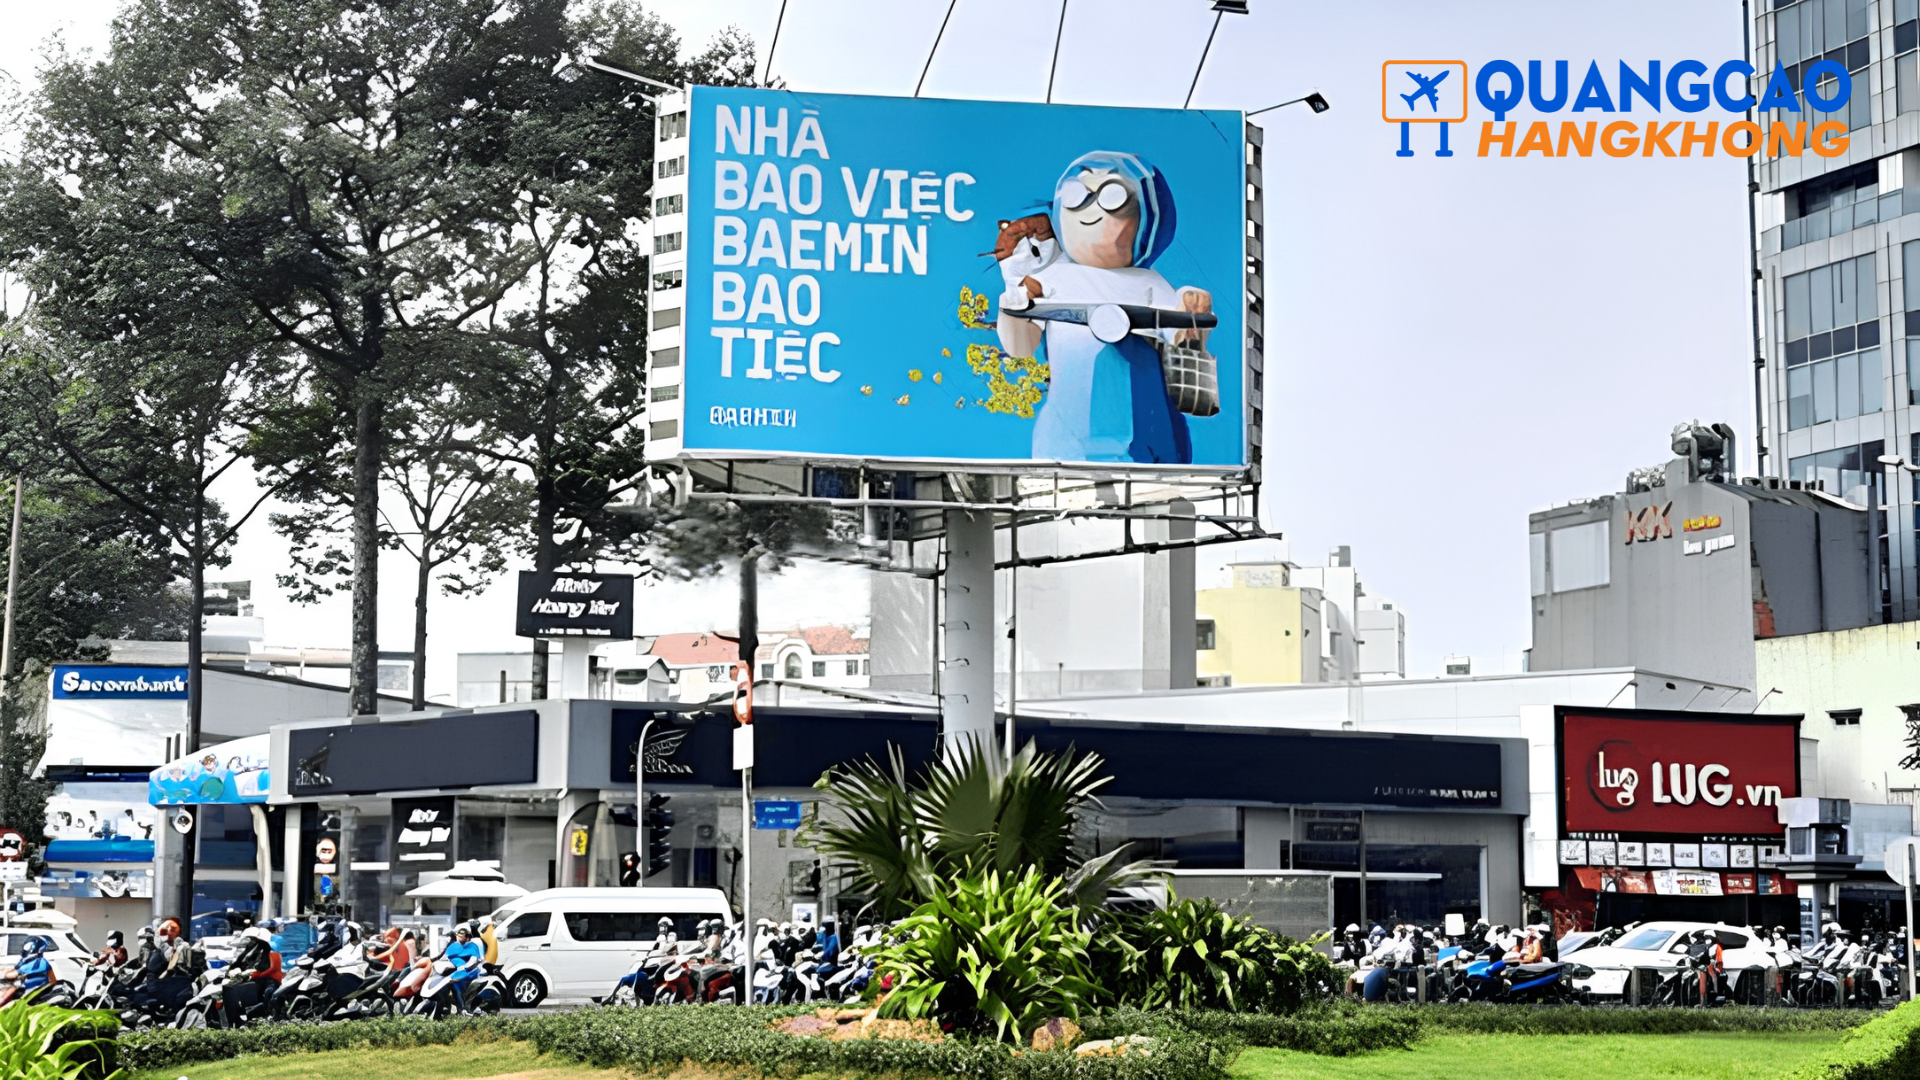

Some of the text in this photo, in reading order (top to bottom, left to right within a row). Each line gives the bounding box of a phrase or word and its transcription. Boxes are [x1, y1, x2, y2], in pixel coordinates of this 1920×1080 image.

[714, 160, 976, 222] BAO VIỆC
[713, 215, 928, 275] BAEMIN
[712, 271, 821, 326] BAO
[710, 326, 841, 383] TIỆC
[1652, 761, 1782, 806] LUG.vn
